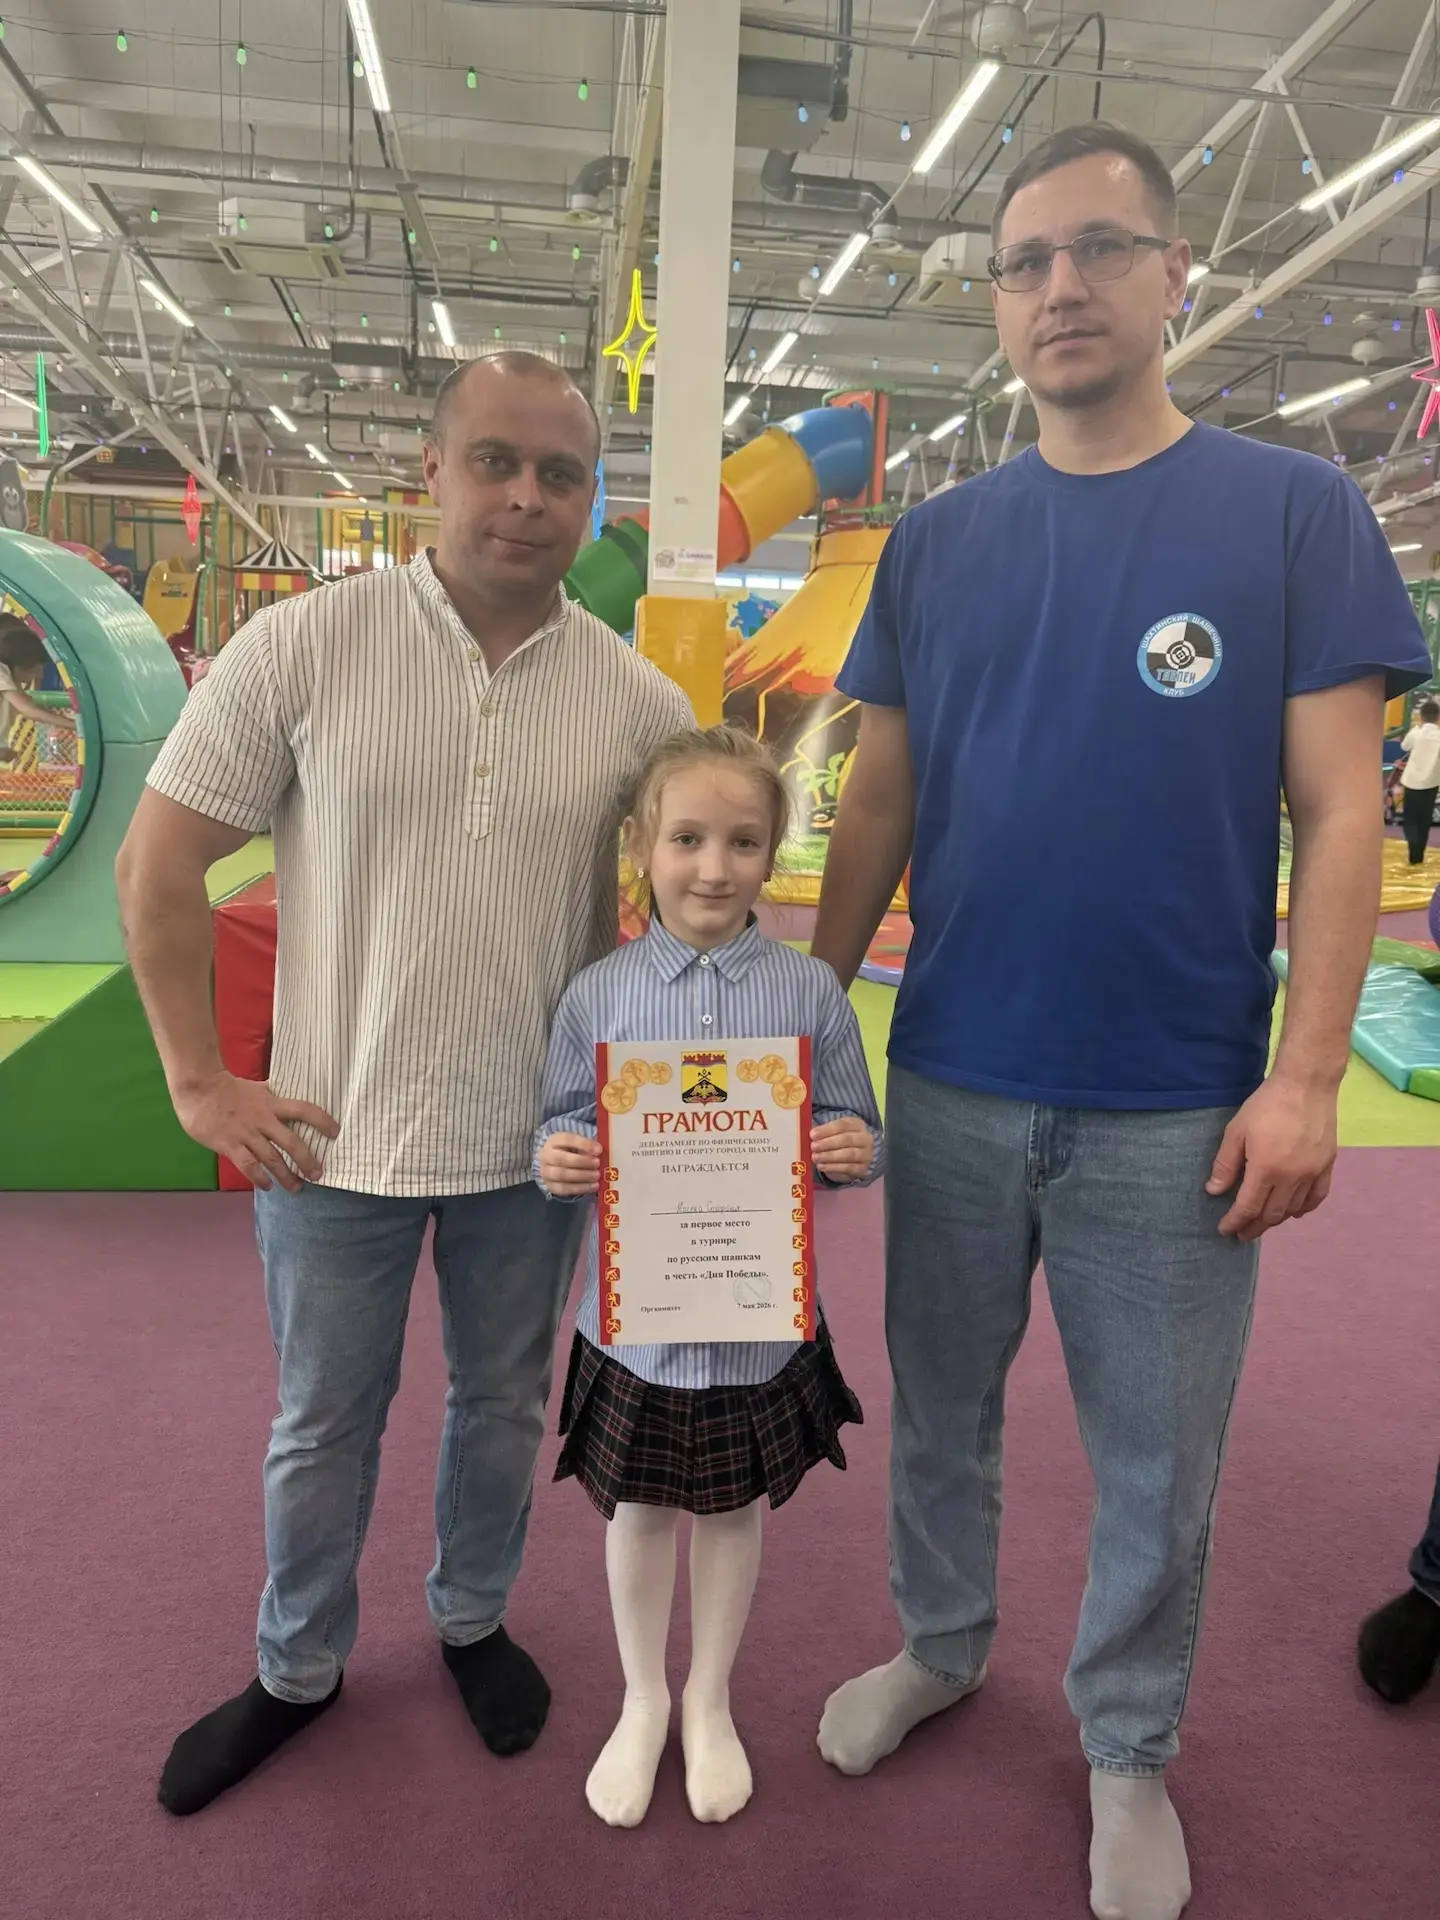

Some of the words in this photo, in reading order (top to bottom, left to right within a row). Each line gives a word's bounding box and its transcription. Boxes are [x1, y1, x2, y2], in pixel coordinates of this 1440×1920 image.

[1141, 614, 1189, 649] ШАХТИНСКИЙ
[1191, 615, 1222, 658] ШАШЕЧНЫЙ
[1163, 687, 1185, 696] КЛУБ
[642, 1110, 768, 1134] ГРАМОТА
[638, 1139, 696, 1149] ДЕПАРТАМЕНТ
[698, 1139, 710, 1147] ПО
[711, 1137, 770, 1146] ФИЗИЧЕСКОМУ
[631, 1149, 674, 1157] РАЗВИТИЮ
[683, 1147, 714, 1155] СПОРТУ
[716, 1146, 747, 1154] ГОРОДА
[748, 1145, 779, 1153] ШАХТЫ
[662, 1162, 750, 1174] НАГРАЖДАЕТСЯ
[680, 1221, 689, 1229] за
[690, 1220, 723, 1230] первое
[724, 1219, 751, 1228] место
[699, 1237, 737, 1247] турнире
[667, 1256, 678, 1264] по
[680, 1254, 719, 1265] русским
[721, 1253, 761, 1262] шашкам
[664, 1273, 670, 1281] в
[672, 1272, 698, 1280] честь
[700, 1270, 724, 1280] «Дня
[726, 1268, 769, 1280] Победы».
[640, 1305, 681, 1314] Оргкомитет
